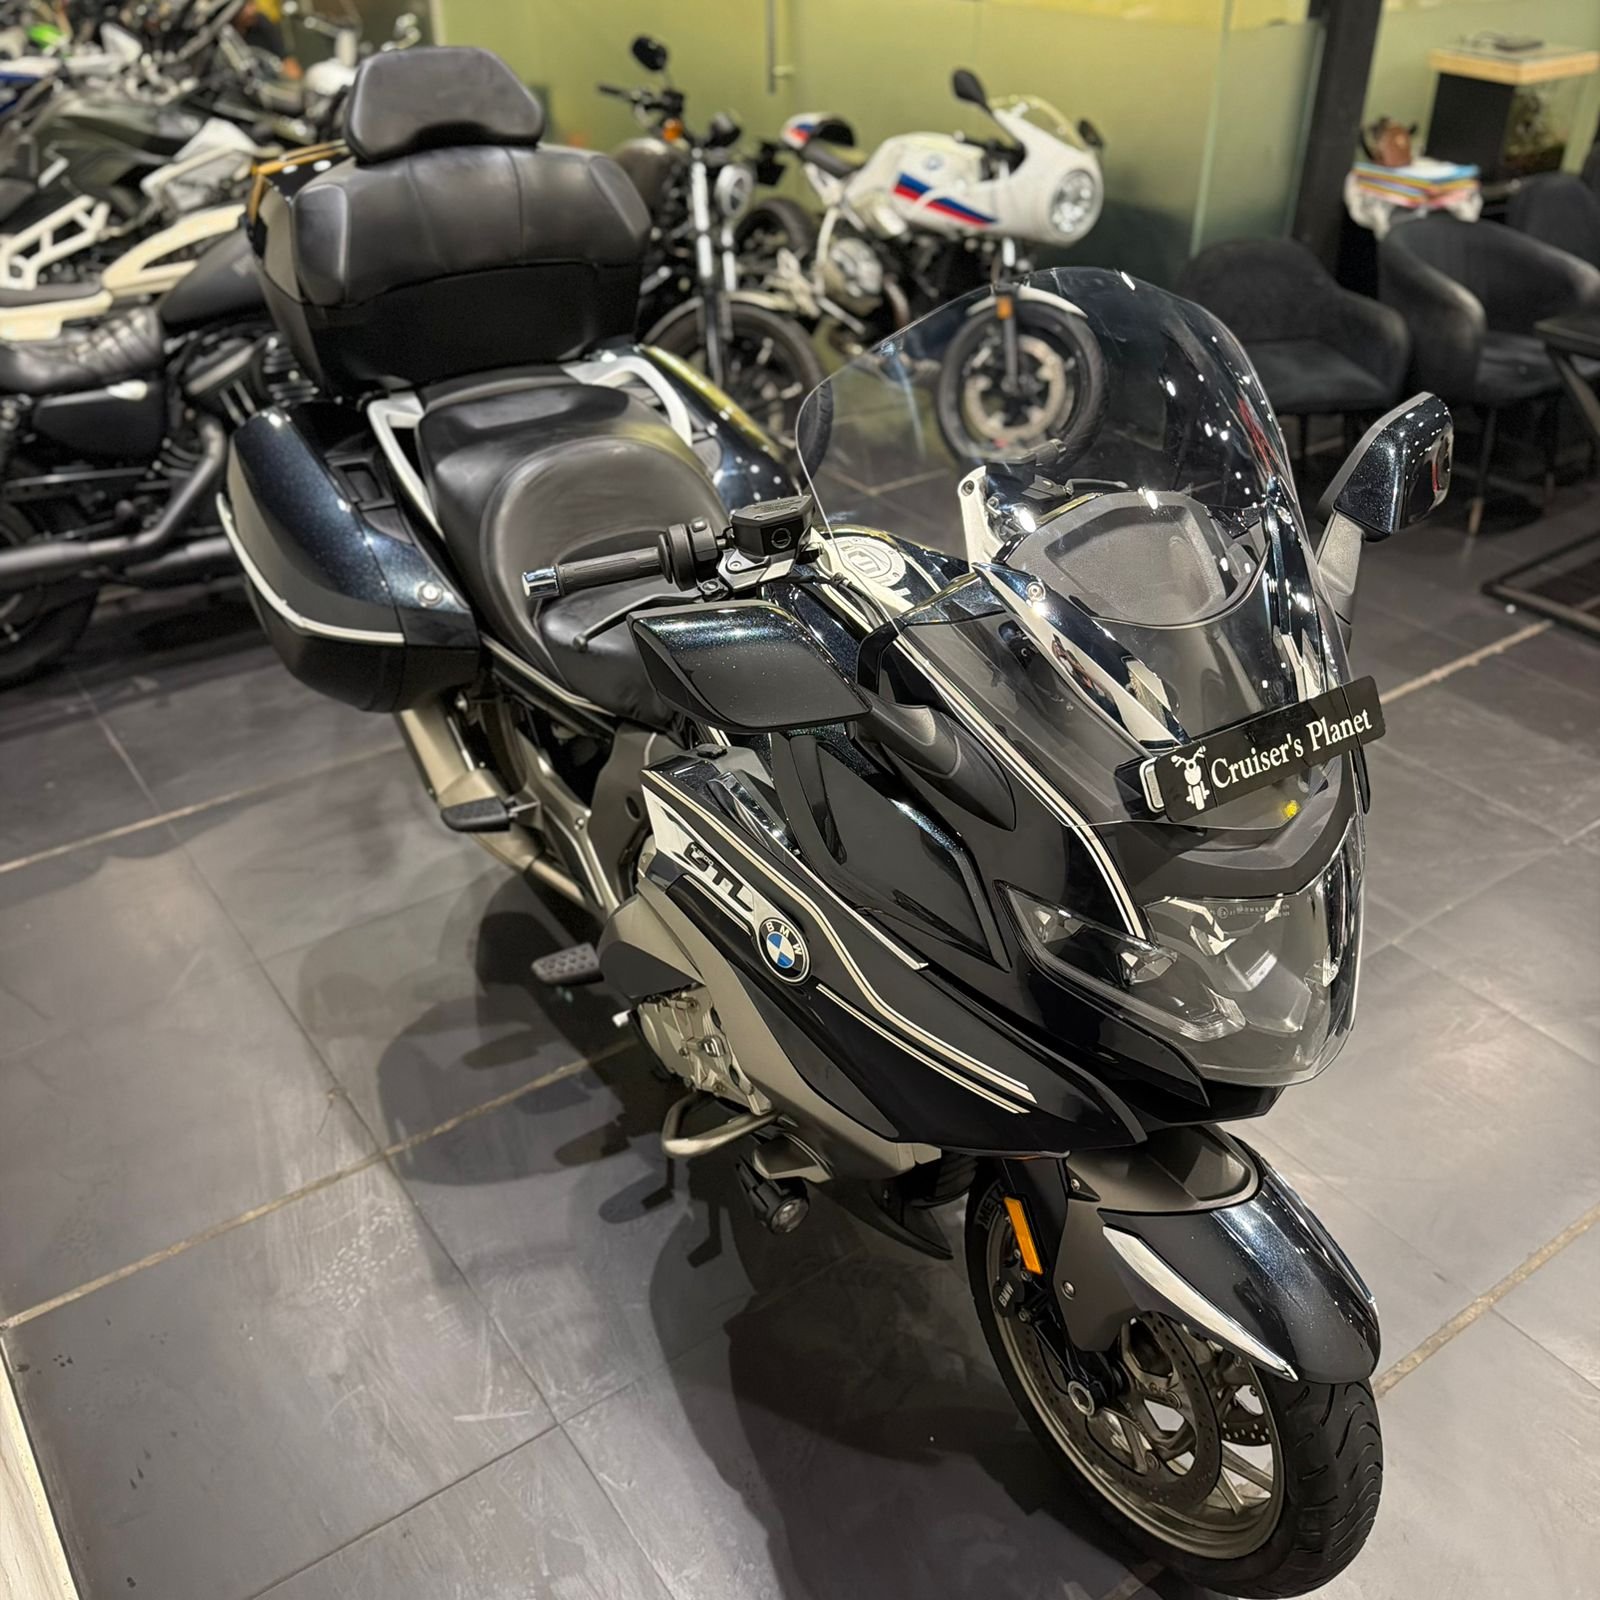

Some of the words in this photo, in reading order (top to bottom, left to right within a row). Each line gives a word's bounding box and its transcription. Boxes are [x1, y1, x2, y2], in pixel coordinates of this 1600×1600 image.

[1211, 735, 1303, 789] Cruiser's
[1306, 710, 1373, 751] Planet
[683, 842, 754, 912] GTL
[765, 922, 802, 955] BMW
[998, 1282, 1015, 1307] BMW
